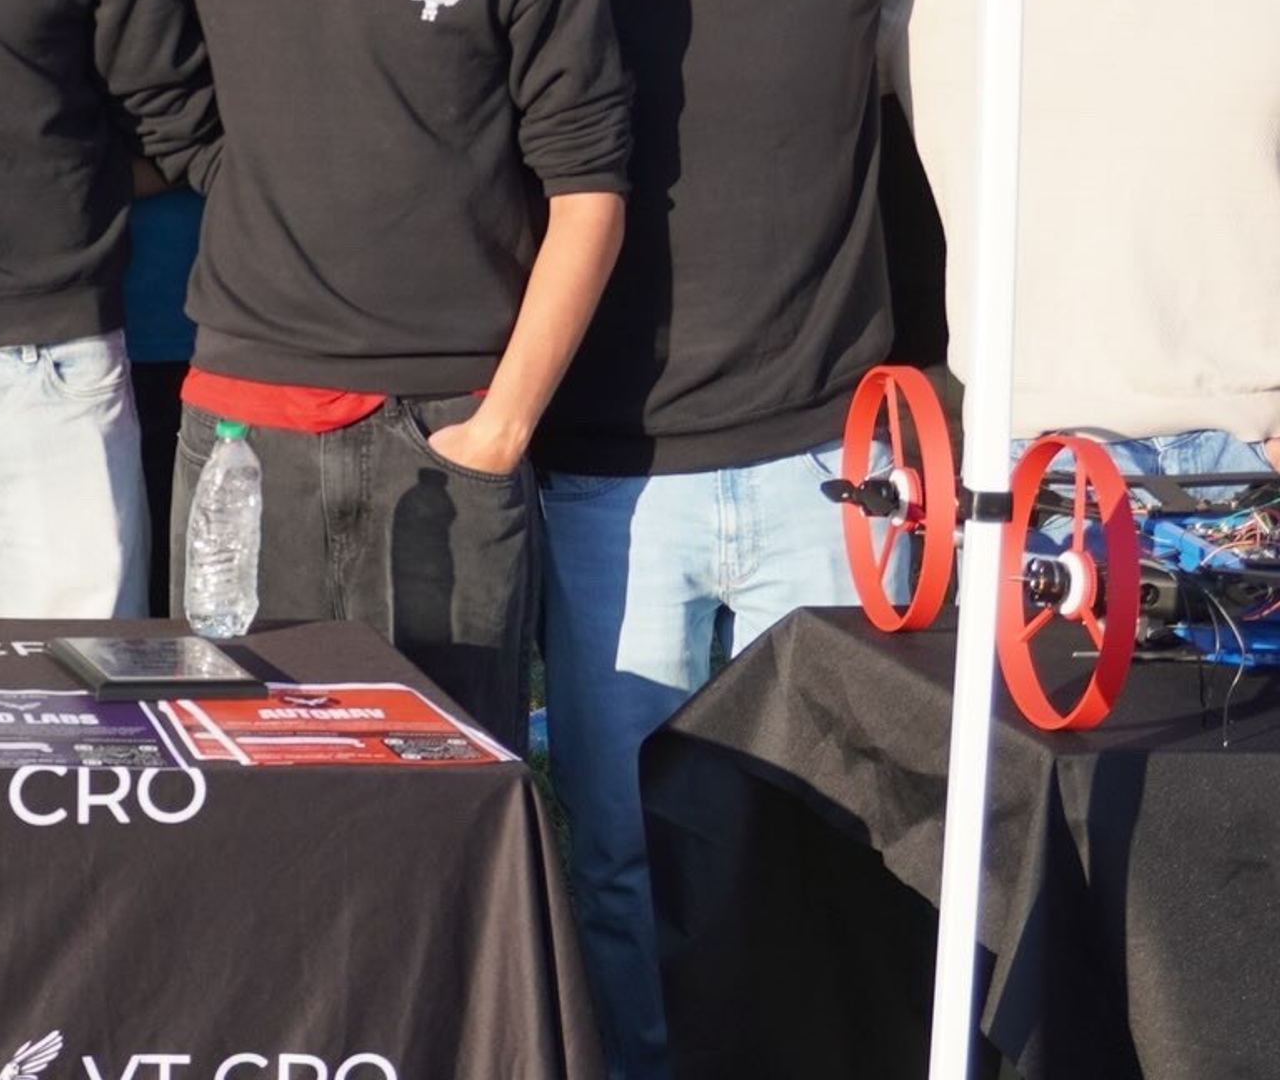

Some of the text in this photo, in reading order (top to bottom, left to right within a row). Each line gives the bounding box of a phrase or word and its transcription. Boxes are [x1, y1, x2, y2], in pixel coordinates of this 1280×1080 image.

[23, 712, 100, 726] LABS
[257, 707, 386, 722] AUTONAV
[9, 764, 208, 827] CRO
